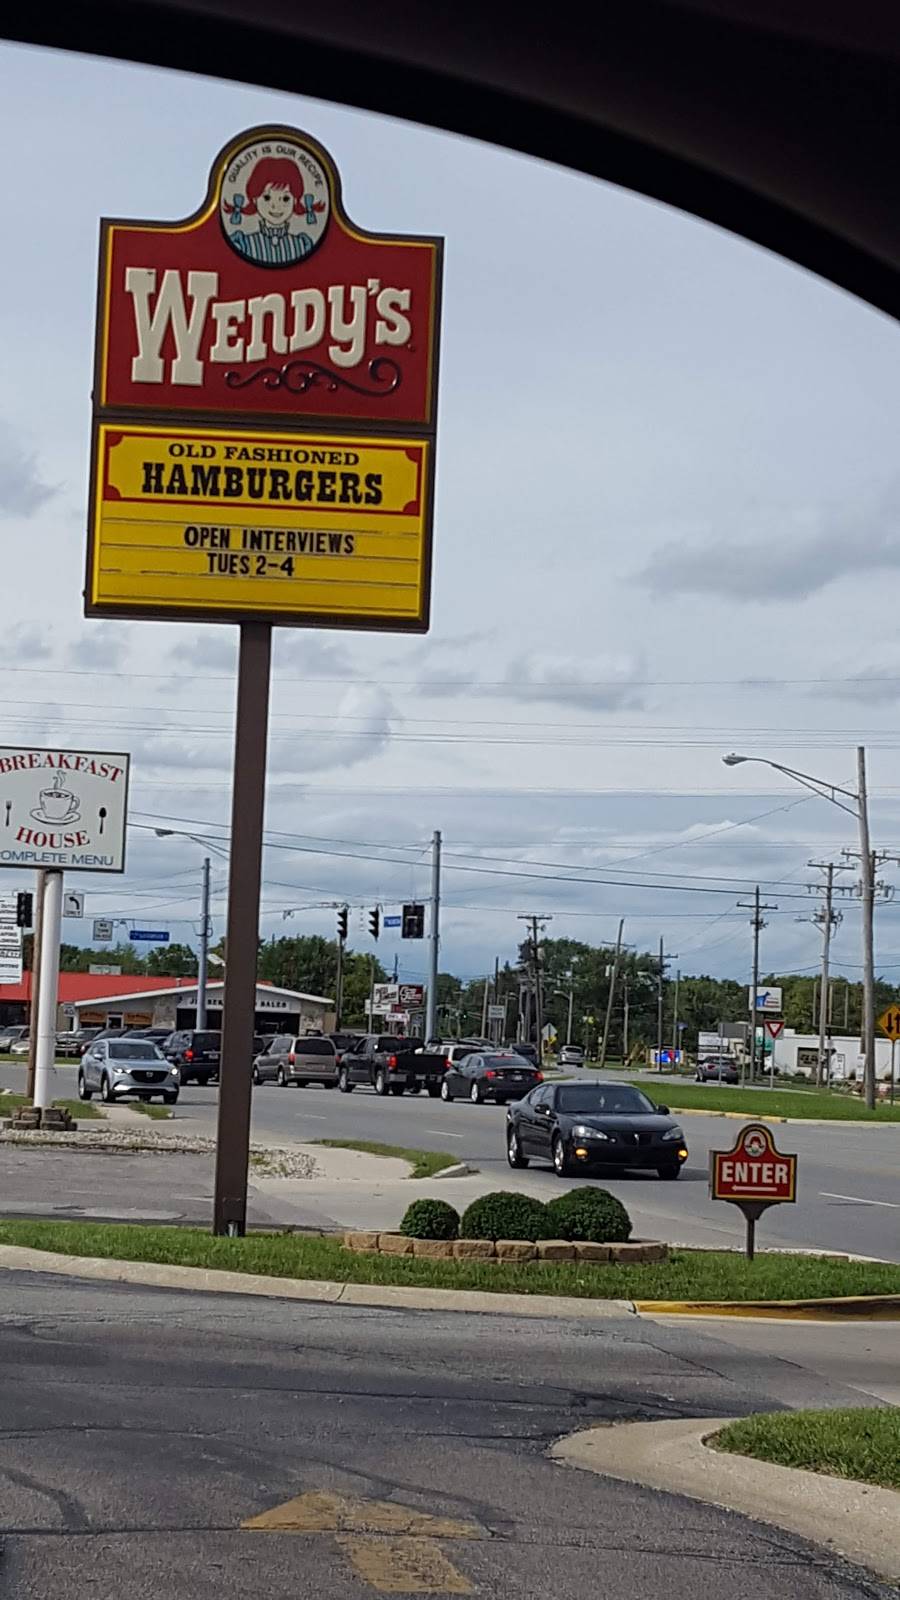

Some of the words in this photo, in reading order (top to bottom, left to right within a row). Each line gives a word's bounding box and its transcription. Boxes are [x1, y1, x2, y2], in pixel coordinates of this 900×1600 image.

[228, 149, 258, 183] QUALITY
[261, 145, 272, 154] IS
[276, 144, 297, 158] OUR
[298, 153, 323, 186] RECIPE
[167, 442, 217, 459] OLD
[224, 445, 360, 467] FASHIONED
[141, 462, 384, 506] HAMBURGERS
[183, 526, 231, 549] OPEN
[242, 529, 355, 555] INTERVIEWS
[207, 552, 251, 575] TUES
[255, 555, 295, 577] 2-4
[0, 753, 124, 783] BREAKFAST
[15, 826, 91, 849] HOUSE
[0, 850, 68, 864] OMPLETE
[71, 854, 114, 866] MENU
[721, 1161, 788, 1184] ENTER
